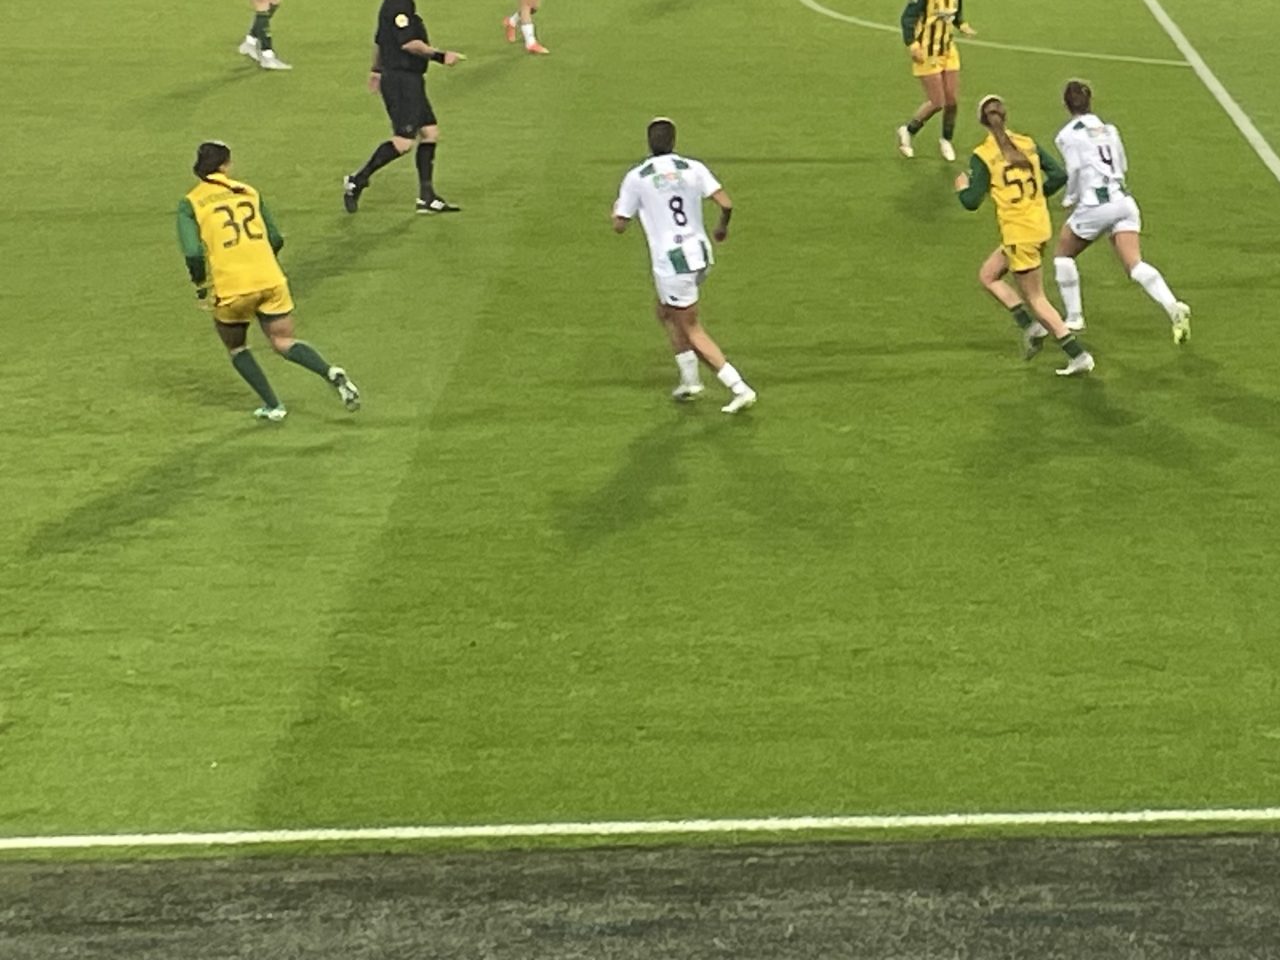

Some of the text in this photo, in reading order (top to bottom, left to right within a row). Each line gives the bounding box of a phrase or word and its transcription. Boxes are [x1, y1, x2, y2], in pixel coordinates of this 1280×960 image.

[1097, 144, 1116, 174] 4
[213, 200, 264, 249] 32
[668, 194, 688, 227] 8
